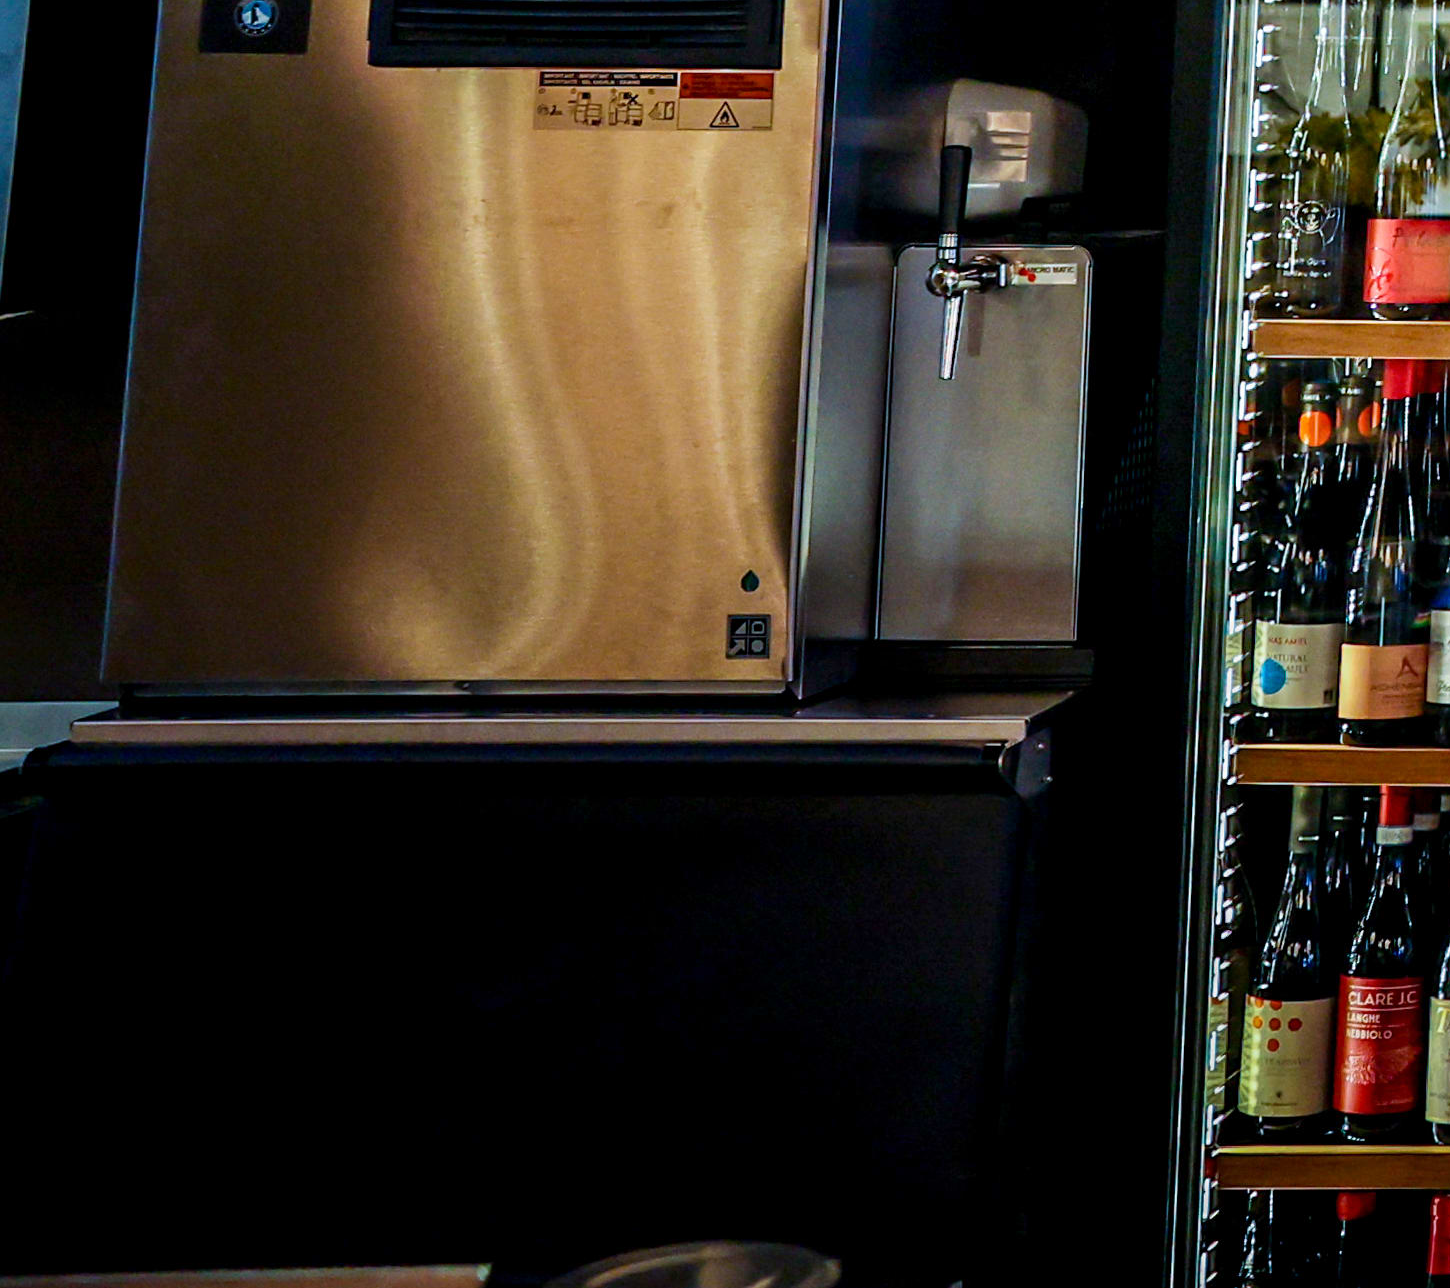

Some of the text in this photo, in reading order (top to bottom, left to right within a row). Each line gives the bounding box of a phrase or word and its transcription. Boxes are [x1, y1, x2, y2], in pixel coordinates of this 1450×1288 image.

[1348, 991, 1394, 1006] CLARE
[1346, 1011, 1381, 1024] LANGHE
[1345, 1028, 1392, 1040] NEBBIOLO
